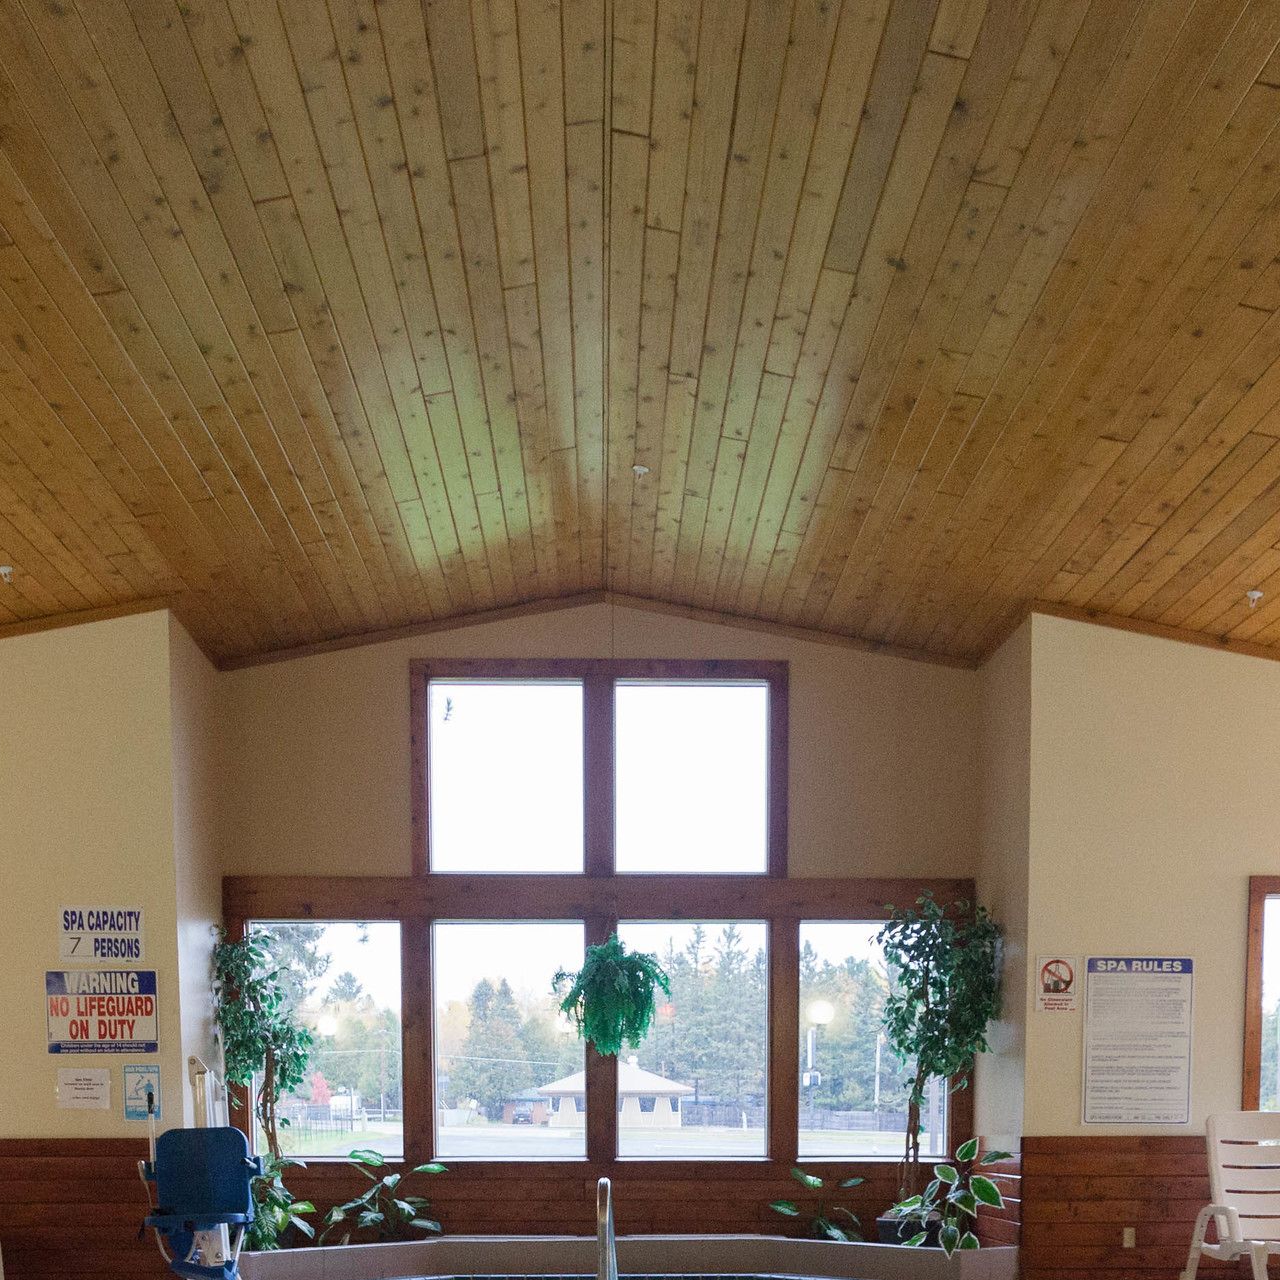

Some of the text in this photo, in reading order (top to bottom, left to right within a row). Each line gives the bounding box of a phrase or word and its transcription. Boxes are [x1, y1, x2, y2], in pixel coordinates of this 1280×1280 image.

[63, 910, 141, 932] SPA CAPACITY
[70, 936, 140, 959] 7 PERSONS
[1096, 961, 1183, 972] SPA RULES
[64, 972, 139, 994] WARNING
[49, 996, 154, 1017] NO LIFEGUARD
[69, 1019, 136, 1040] ON DUTY
